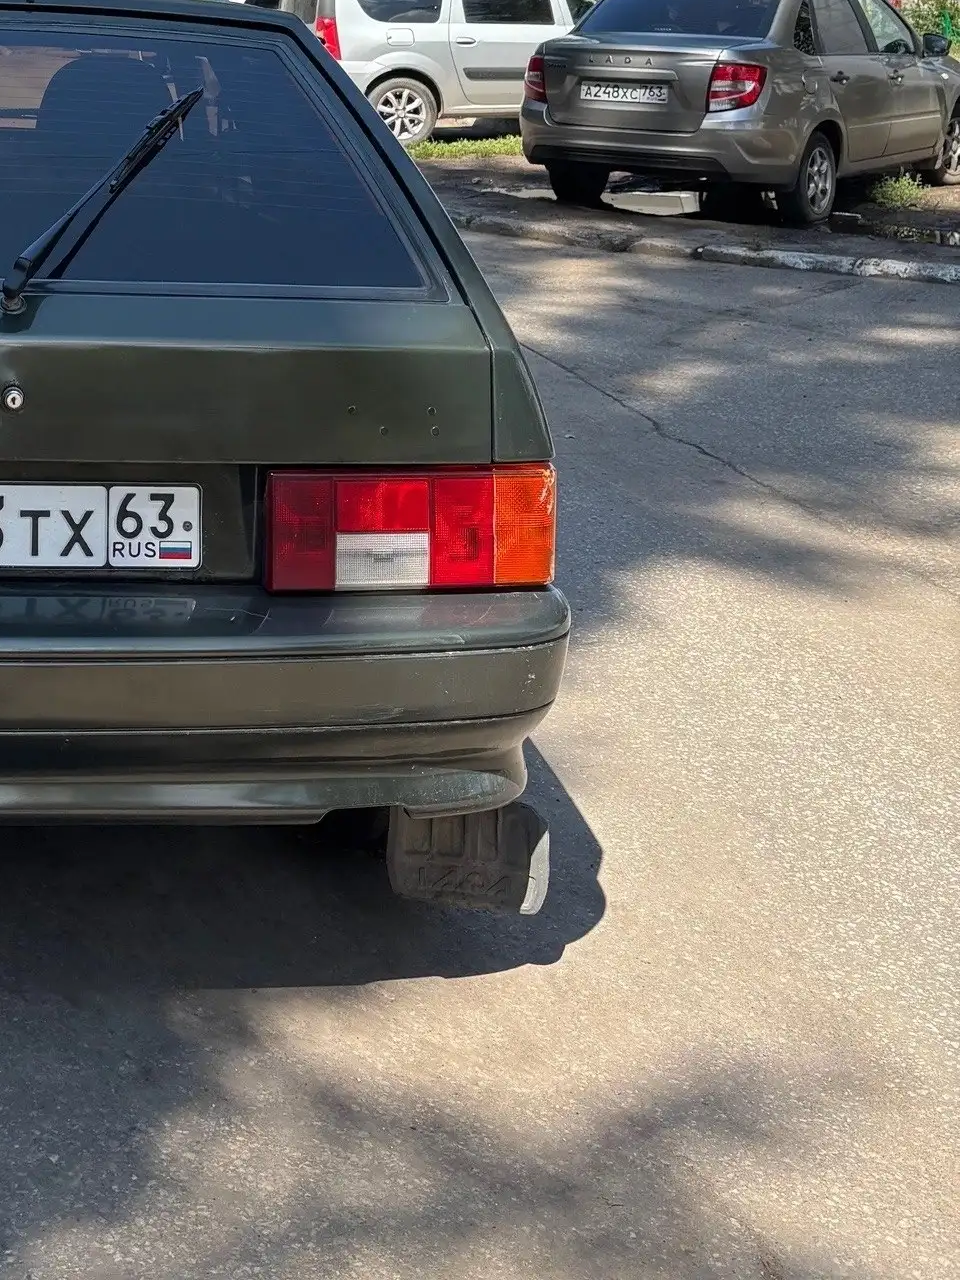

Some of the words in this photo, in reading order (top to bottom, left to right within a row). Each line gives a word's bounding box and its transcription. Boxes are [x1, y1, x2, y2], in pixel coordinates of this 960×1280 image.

[588, 54, 653, 66] LADA
[115, 492, 175, 539] 63
[112, 541, 157, 558] RUS
